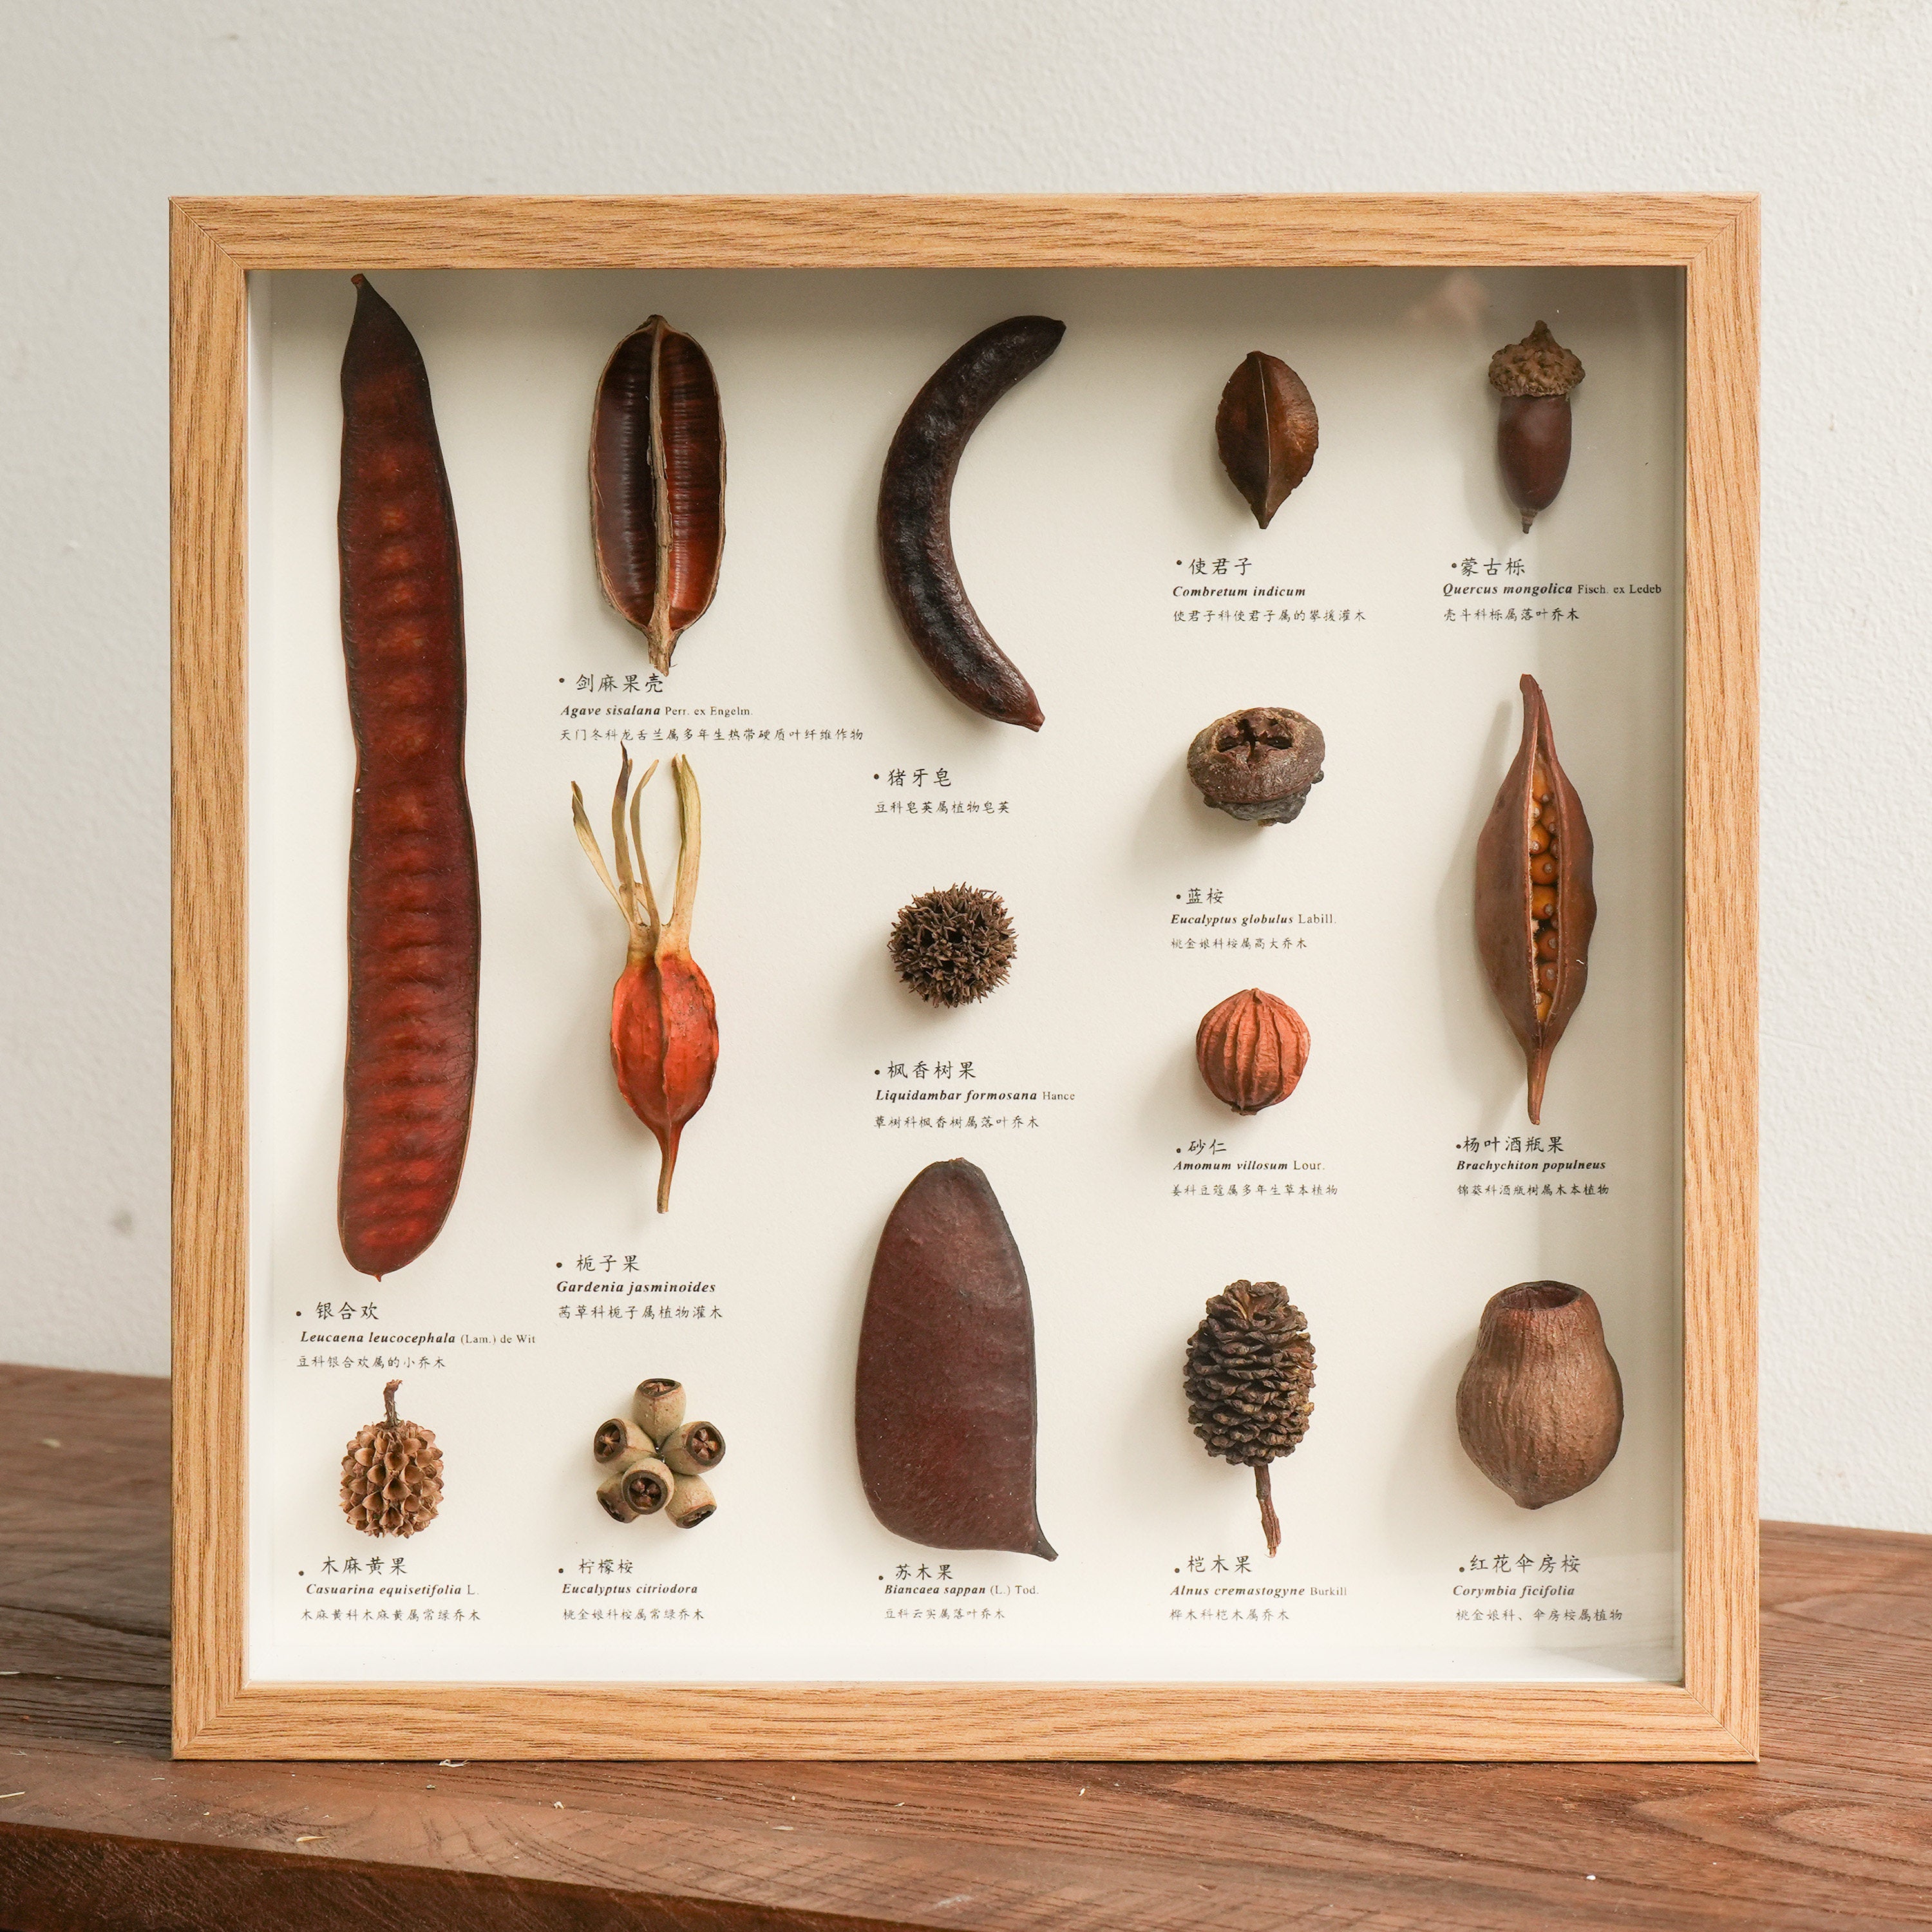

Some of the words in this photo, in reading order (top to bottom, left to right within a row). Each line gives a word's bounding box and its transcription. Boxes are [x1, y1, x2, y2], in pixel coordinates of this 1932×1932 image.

[1188, 557, 1253, 576] 使君子
[1461, 556, 1526, 577] 蒙古栎
[1172, 585, 1248, 597] Combretum
[1253, 585, 1306, 597] indicum
[1443, 582, 1498, 597] Quercus
[1502, 582, 1573, 597] mongolica
[1629, 584, 1662, 594] Ledeb
[1443, 607, 1580, 623] 壳斗科栎属落叶乔木
[576, 673, 664, 694] 剑麻果壳
[560, 705, 601, 719] Agave
[605, 705, 661, 716] sisalana
[665, 706, 690, 716] Perr.
[710, 706, 753, 718] Engelm.
[560, 728, 864, 742] 天门冬科龙舌兰属多年生热带硬质叶纤维作物
[886, 767, 952, 788] 猪牙皂
[1186, 887, 1224, 905] 蓝桉
[1170, 913, 1238, 927] Eucalyptus
[1240, 913, 1294, 927] globulus
[1298, 913, 1338, 924] Labill.
[1170, 937, 1307, 951] 桃金娘科桉属高大乔木
[887, 1060, 976, 1080] 枫香树果
[875, 1089, 962, 1103] Liquidambar
[963, 1089, 1037, 1104] formosana
[1041, 1090, 1075, 1101] Hance
[1187, 1138, 1227, 1156] 砂仁
[1462, 1135, 1564, 1154] 杨叶酒瓶果
[1173, 1160, 1231, 1171] Amomum
[1236, 1160, 1288, 1171] villosum
[1293, 1160, 1325, 1171] Lour.
[1456, 1159, 1539, 1173] Brachychiton
[1541, 1159, 1606, 1173] populneus
[1171, 1183, 1338, 1197] 姜科豆蔻属多年生草本植物
[1457, 1183, 1609, 1197] 锦葵科酒瓶树属木本植物
[576, 1254, 640, 1273] 栀子果
[556, 1280, 624, 1293] Gardenia
[626, 1280, 716, 1296] jasminoides
[315, 1301, 379, 1320] 银合欢
[558, 1304, 723, 1321] 茜草科栀子属植物灌木
[299, 1331, 364, 1343] Leucaena
[368, 1331, 455, 1346] leucocephala
[460, 1332, 497, 1345] (Lam.)
[500, 1332, 513, 1343] de
[516, 1332, 536, 1343] Wit
[296, 1355, 446, 1370] 豆科银合欢属的小乔木
[321, 1555, 408, 1576] 木麻黄果
[578, 1558, 634, 1575] 柠檬桉
[1186, 1554, 1253, 1574] 桤木果
[1470, 1553, 1581, 1574] 红花伞房桉
[895, 1563, 954, 1581] 苏木果
[306, 1584, 375, 1595] Casuarina
[379, 1584, 462, 1598] equisetifolia
[562, 1583, 632, 1596] Eucalyptus
[636, 1583, 698, 1595] citriodora
[884, 1584, 940, 1595] Biancaea
[943, 1586, 986, 1597] sappan
[990, 1584, 1010, 1597] (L.)
[1014, 1584, 1039, 1595] Tod.
[1170, 1585, 1209, 1596] Alnus
[1214, 1585, 1305, 1599] cremastogyne
[1310, 1586, 1347, 1596] Burkill
[1453, 1585, 1517, 1599] Corymbia
[1518, 1585, 1575, 1599] ficifolia
[301, 1608, 481, 1622] 木麻黄科木麻黄属常绿乔木
[563, 1608, 705, 1622] 桃金娘科桉属常绿乔木
[884, 1607, 1005, 1621] 豆科云实属落叶乔木
[1169, 1608, 1289, 1622] 桦木科桤木属乔木
[1455, 1608, 1623, 1623] 桃金娘科、伞房桉属植物
